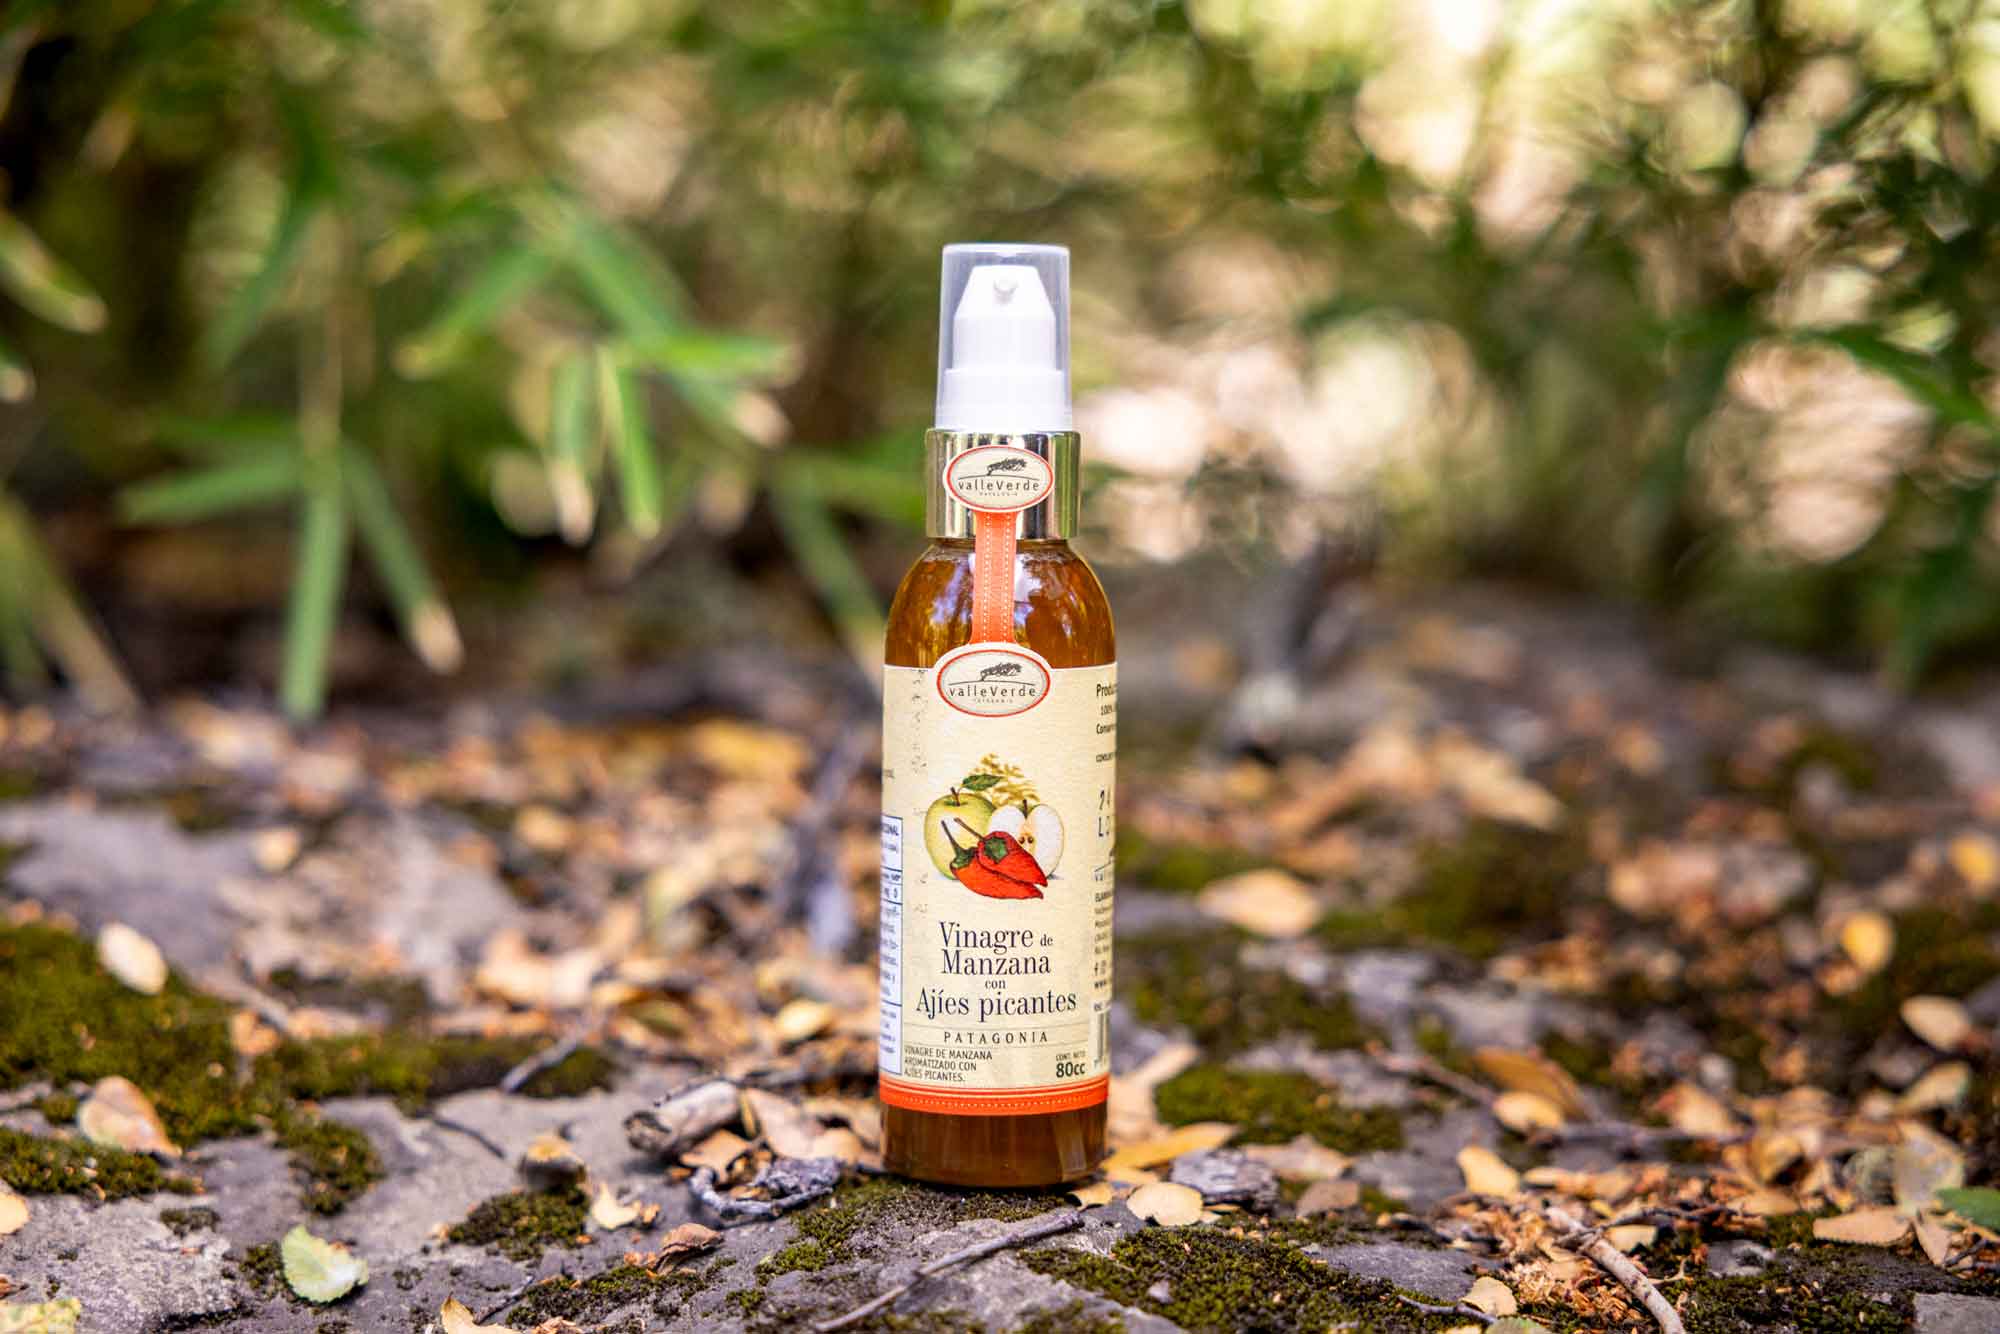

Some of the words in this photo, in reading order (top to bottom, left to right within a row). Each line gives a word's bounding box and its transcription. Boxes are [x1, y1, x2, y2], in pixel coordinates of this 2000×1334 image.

[958, 479, 1040, 492] valleVerde
[948, 684, 1037, 698] valleVerde
[939, 921, 1034, 955] Vinagre
[1040, 933, 1054, 947] de
[940, 948, 1051, 976] Manzana
[984, 978, 1007, 990] con
[916, 986, 969, 1020] Ajíes
[978, 989, 1077, 1023] picantes
[943, 1030, 1048, 1045] PATAGONIA
[904, 1046, 934, 1057] VINAGRE
[936, 1048, 948, 1058] DE
[949, 1049, 993, 1060] MANZANA
[904, 1056, 956, 1070] AROMATIZADO
[958, 1061, 977, 1071] CON
[1056, 1061, 1086, 1078] 80cc
